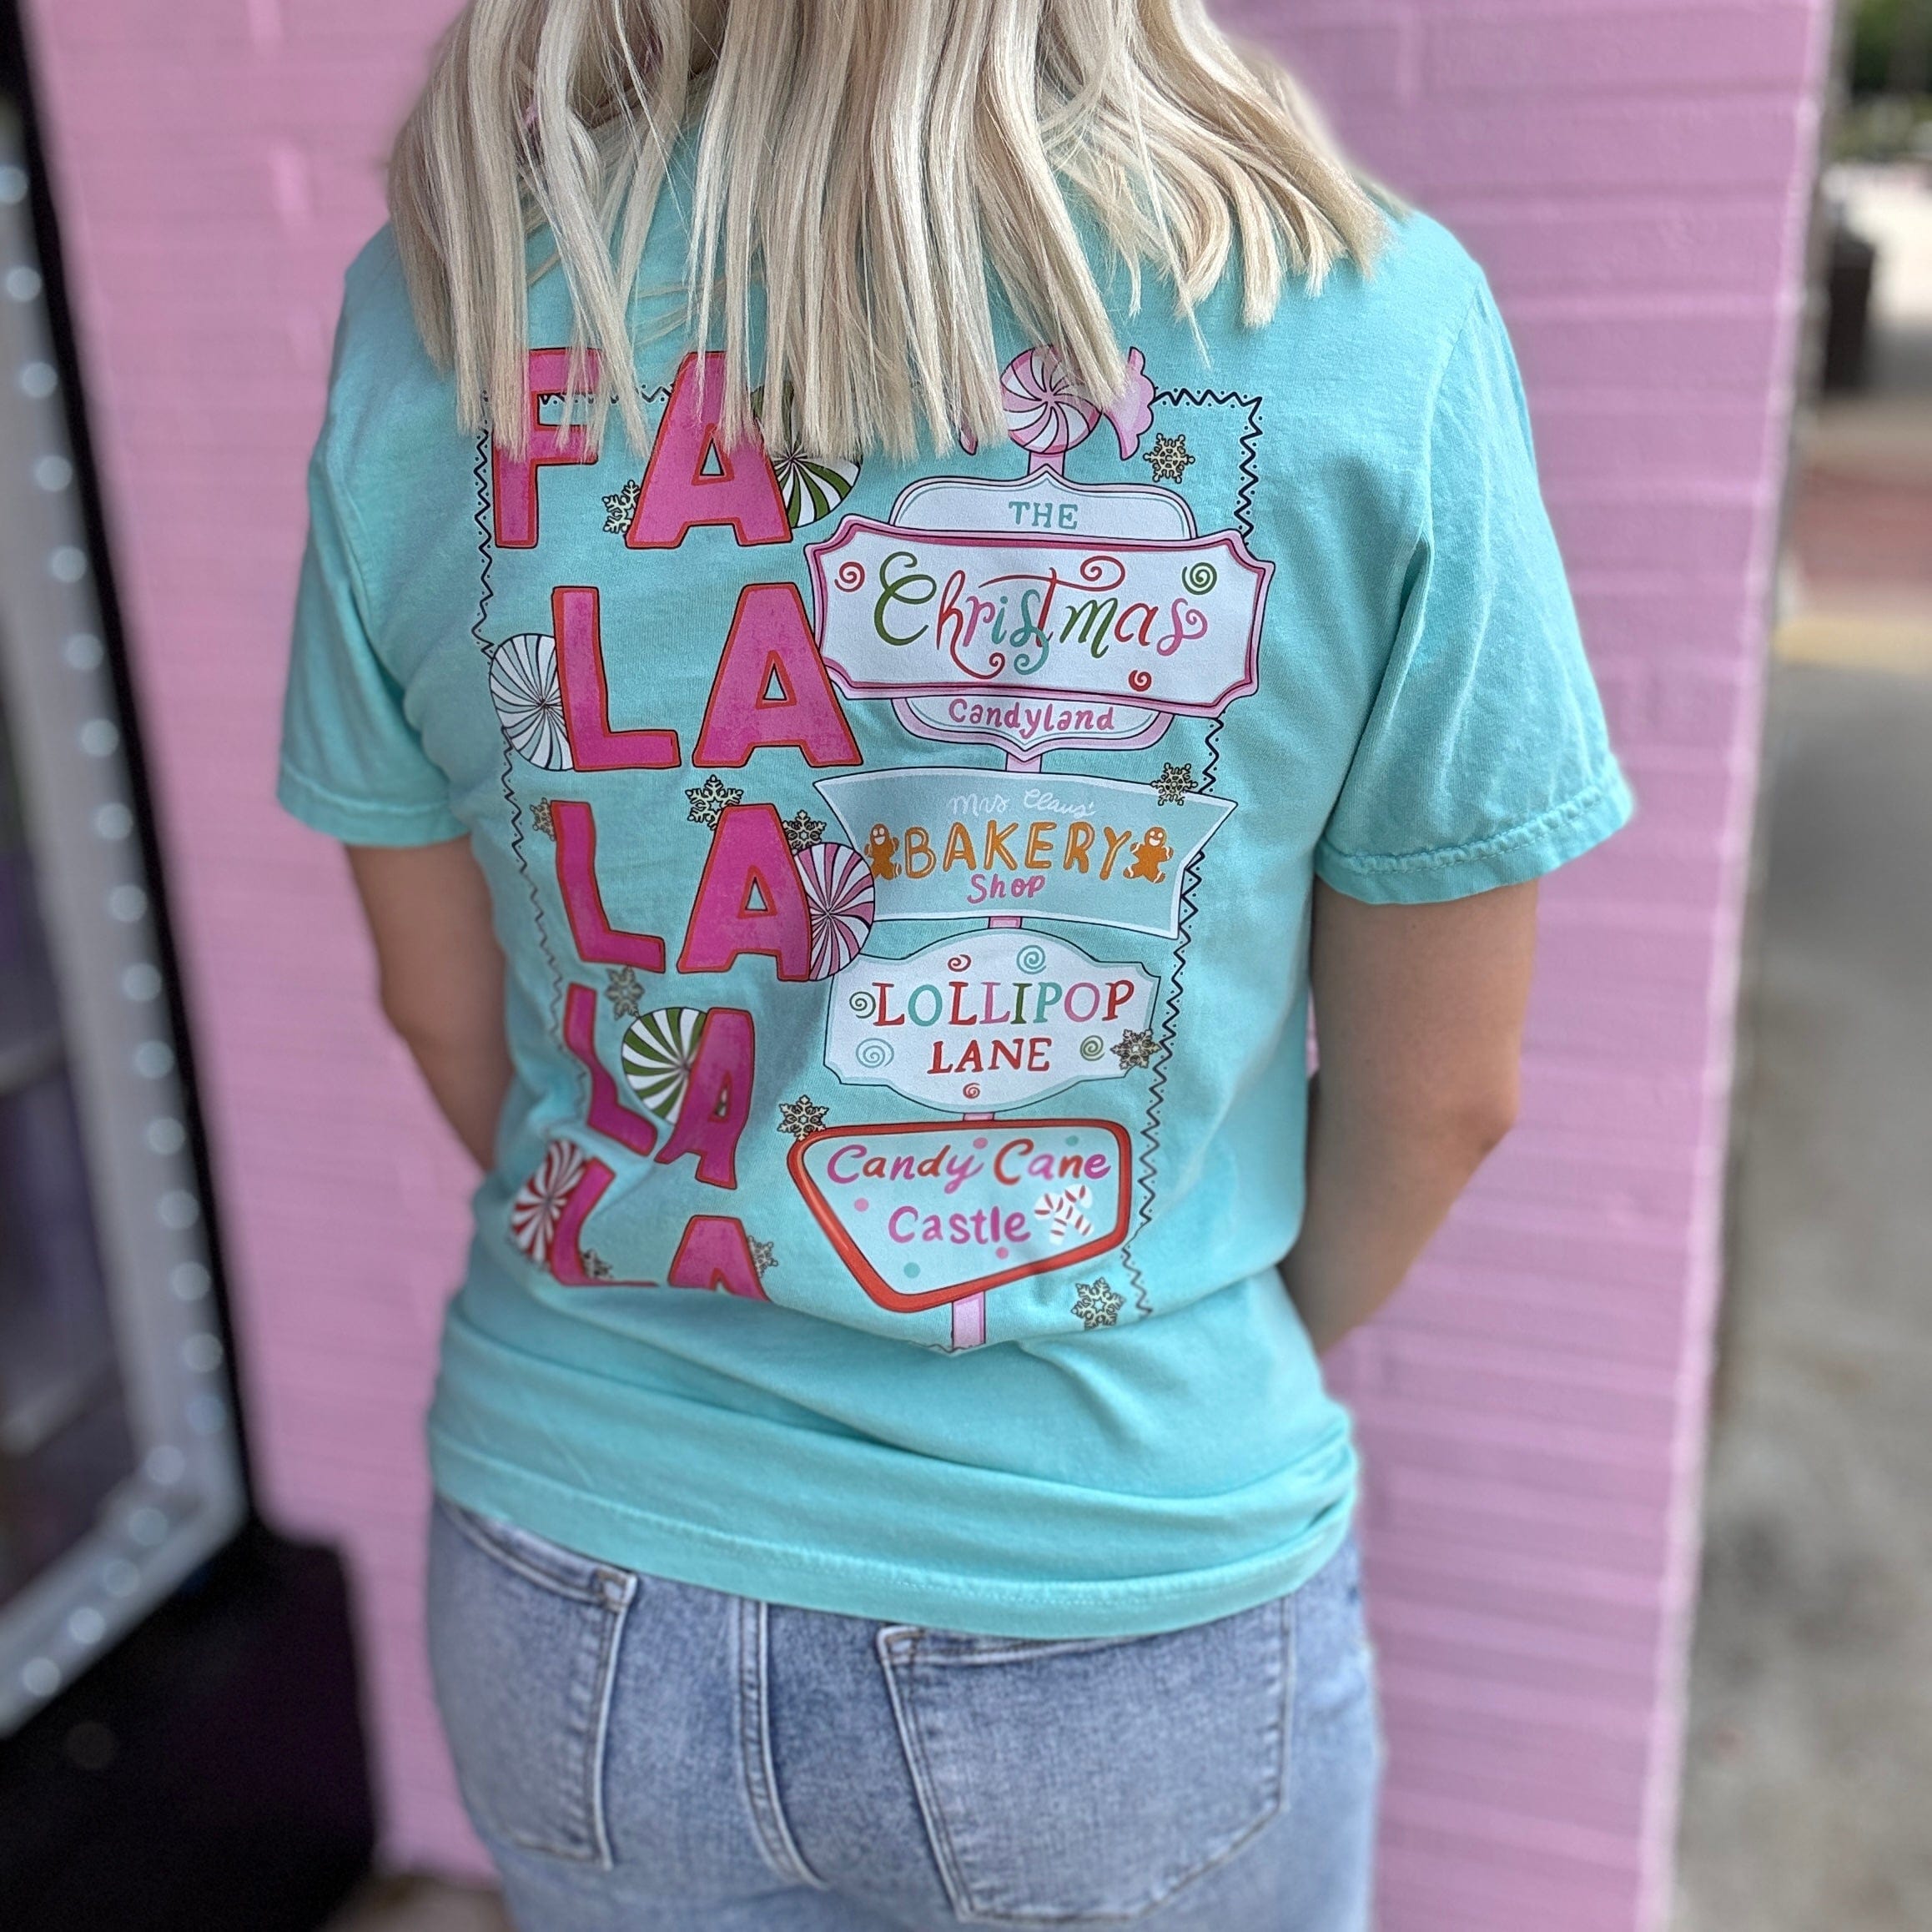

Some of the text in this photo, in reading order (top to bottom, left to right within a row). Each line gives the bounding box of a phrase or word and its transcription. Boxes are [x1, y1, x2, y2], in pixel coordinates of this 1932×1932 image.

[1009, 501, 1079, 530] THE
[874, 551, 1209, 680] Christmas
[551, 582, 863, 772] LA
[948, 697, 1115, 739] Candyland
[948, 792, 1009, 816] Mrs
[903, 820, 1133, 881] BAKERY
[550, 801, 812, 982] LA
[967, 873, 1046, 904] Shop
[872, 980, 1135, 1027] LOLLIPOP
[927, 1038, 1053, 1074] LANE
[564, 984, 756, 1190] LA
[827, 1138, 1112, 1194] Candy Cane
[888, 1205, 1031, 1245] Castle
